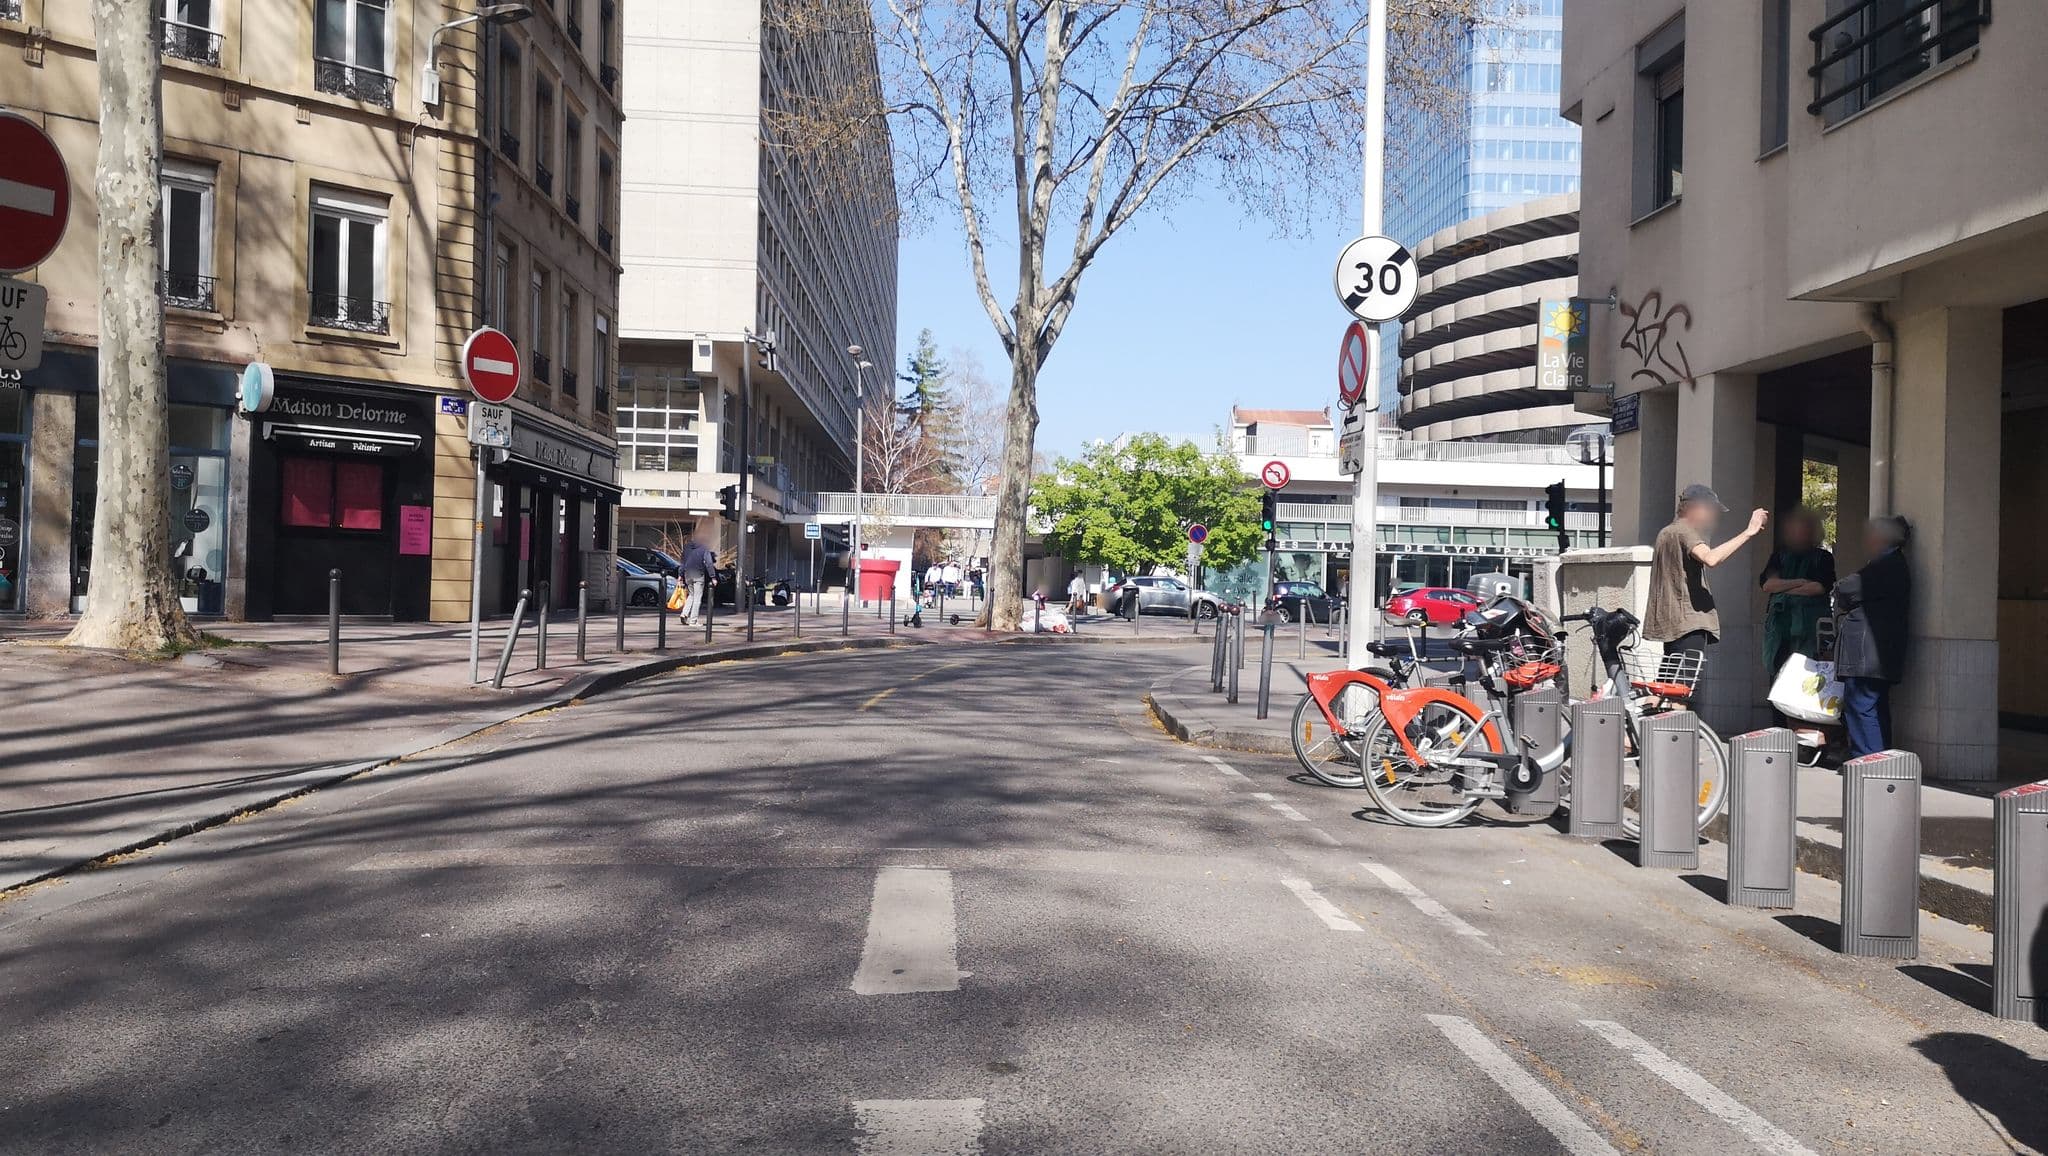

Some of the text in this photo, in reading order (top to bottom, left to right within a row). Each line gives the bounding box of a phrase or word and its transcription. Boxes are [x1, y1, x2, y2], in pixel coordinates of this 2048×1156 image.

[1354, 262, 1401, 295] 30
[1543, 352, 1585, 368] La Vie
[1543, 369, 1583, 387] Claire
[270, 397, 407, 424] Maison Delorme
[482, 407, 504, 420] SAUF
[309, 439, 336, 449] Artisan
[1277, 540, 1549, 556] ES HALS DE LYON PAUL
